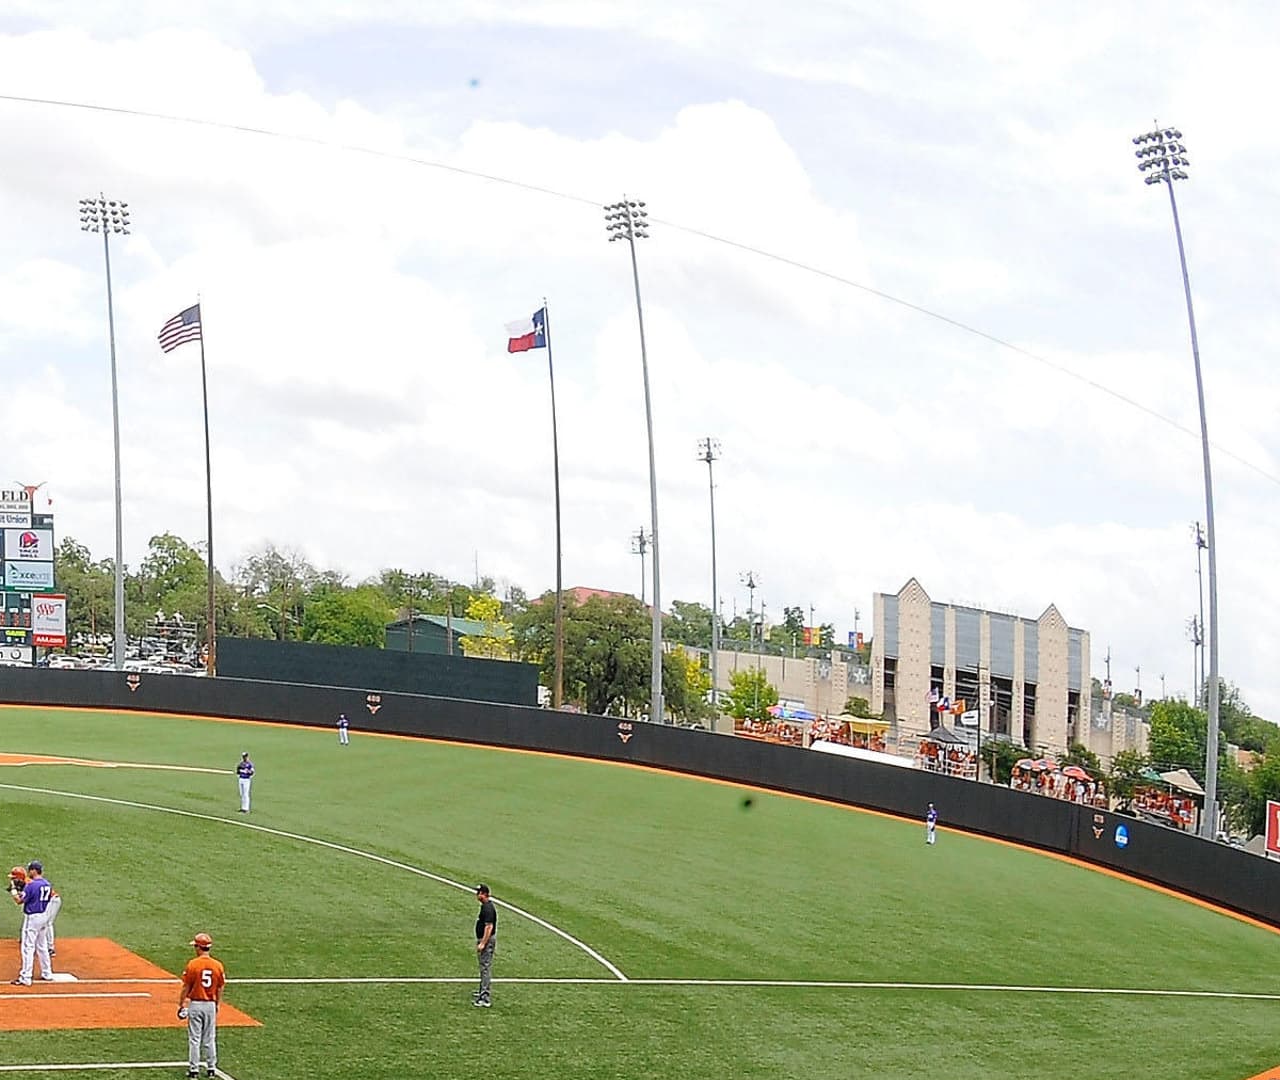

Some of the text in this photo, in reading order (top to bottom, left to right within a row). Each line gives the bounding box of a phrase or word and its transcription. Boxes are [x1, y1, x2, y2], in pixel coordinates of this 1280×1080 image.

[6, 514, 28, 524] Union
[39, 886, 51, 902] 17
[201, 970, 214, 987] 5
